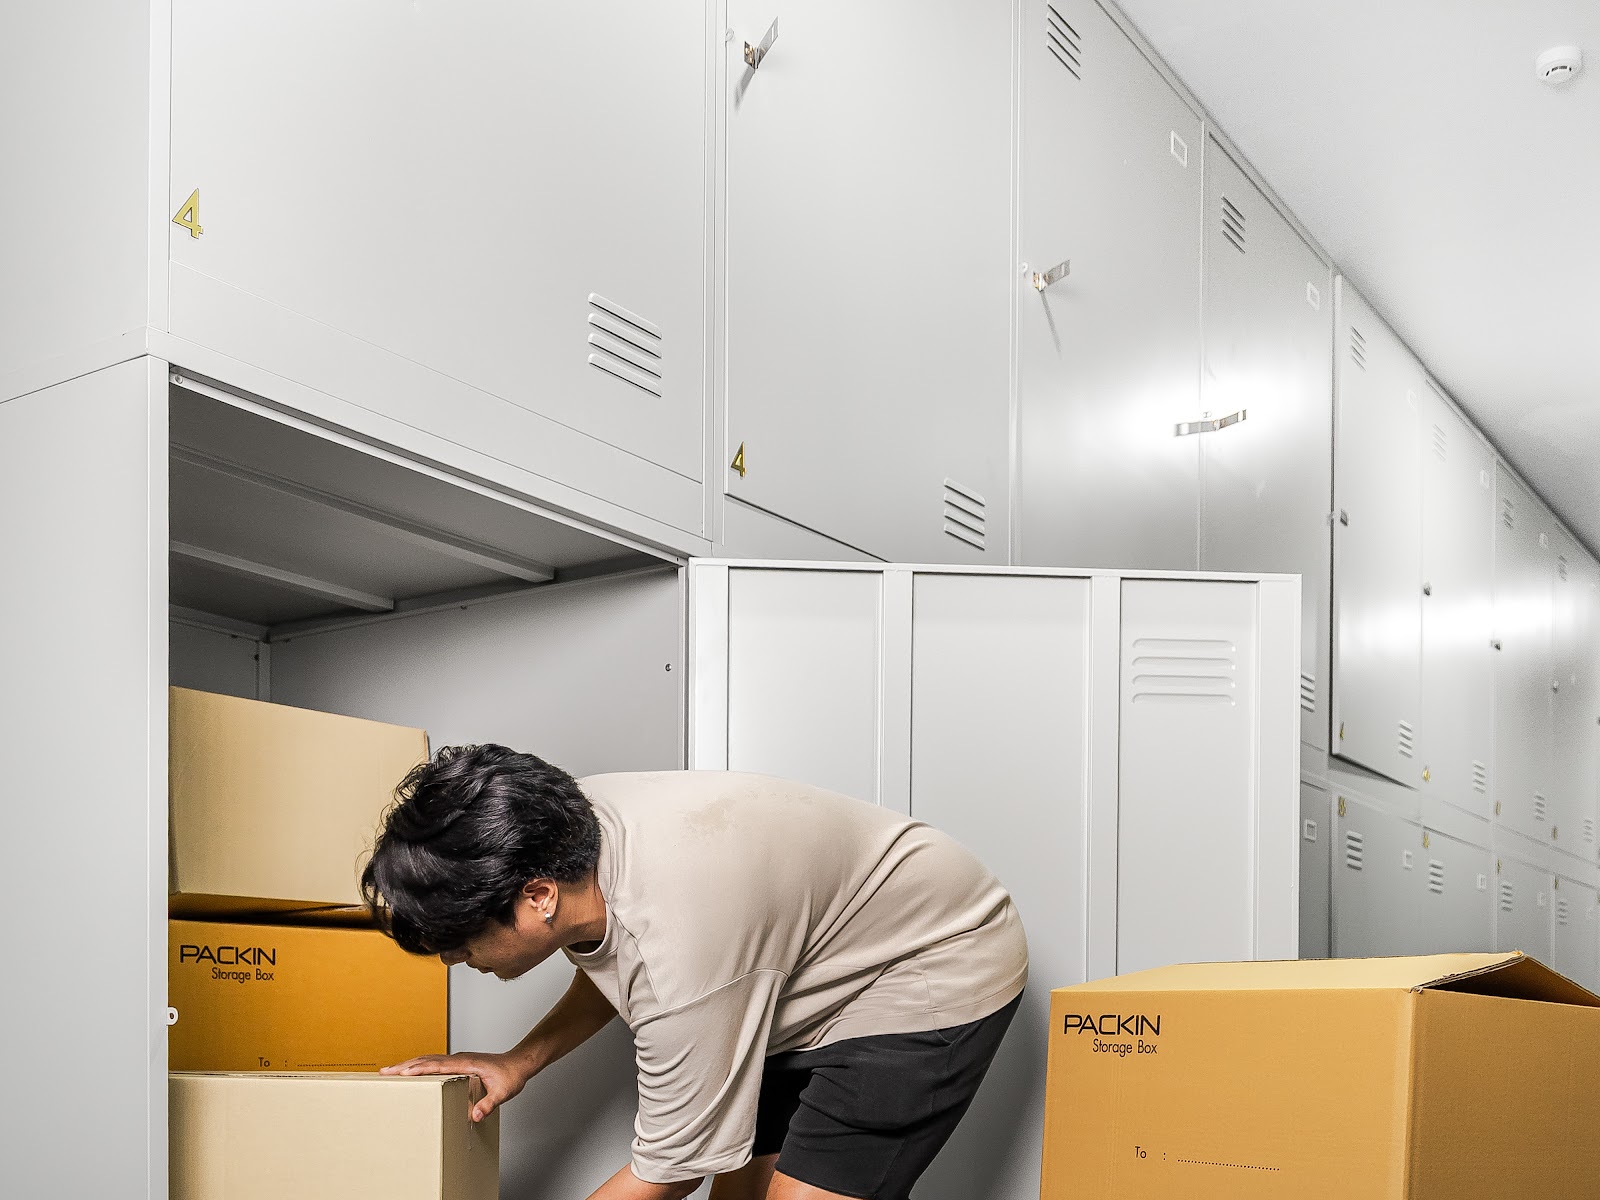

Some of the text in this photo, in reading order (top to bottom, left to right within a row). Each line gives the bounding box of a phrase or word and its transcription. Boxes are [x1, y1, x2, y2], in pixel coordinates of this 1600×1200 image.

[172, 188, 204, 240] 4
[731, 441, 747, 478] 4
[179, 944, 276, 966] PACKIN
[211, 966, 275, 984] Storage Box
[1063, 1014, 1161, 1036] PACKIN
[1092, 1038, 1158, 1058] Storage Box
[258, 1056, 271, 1068] To
[1134, 1145, 1147, 1159] To
